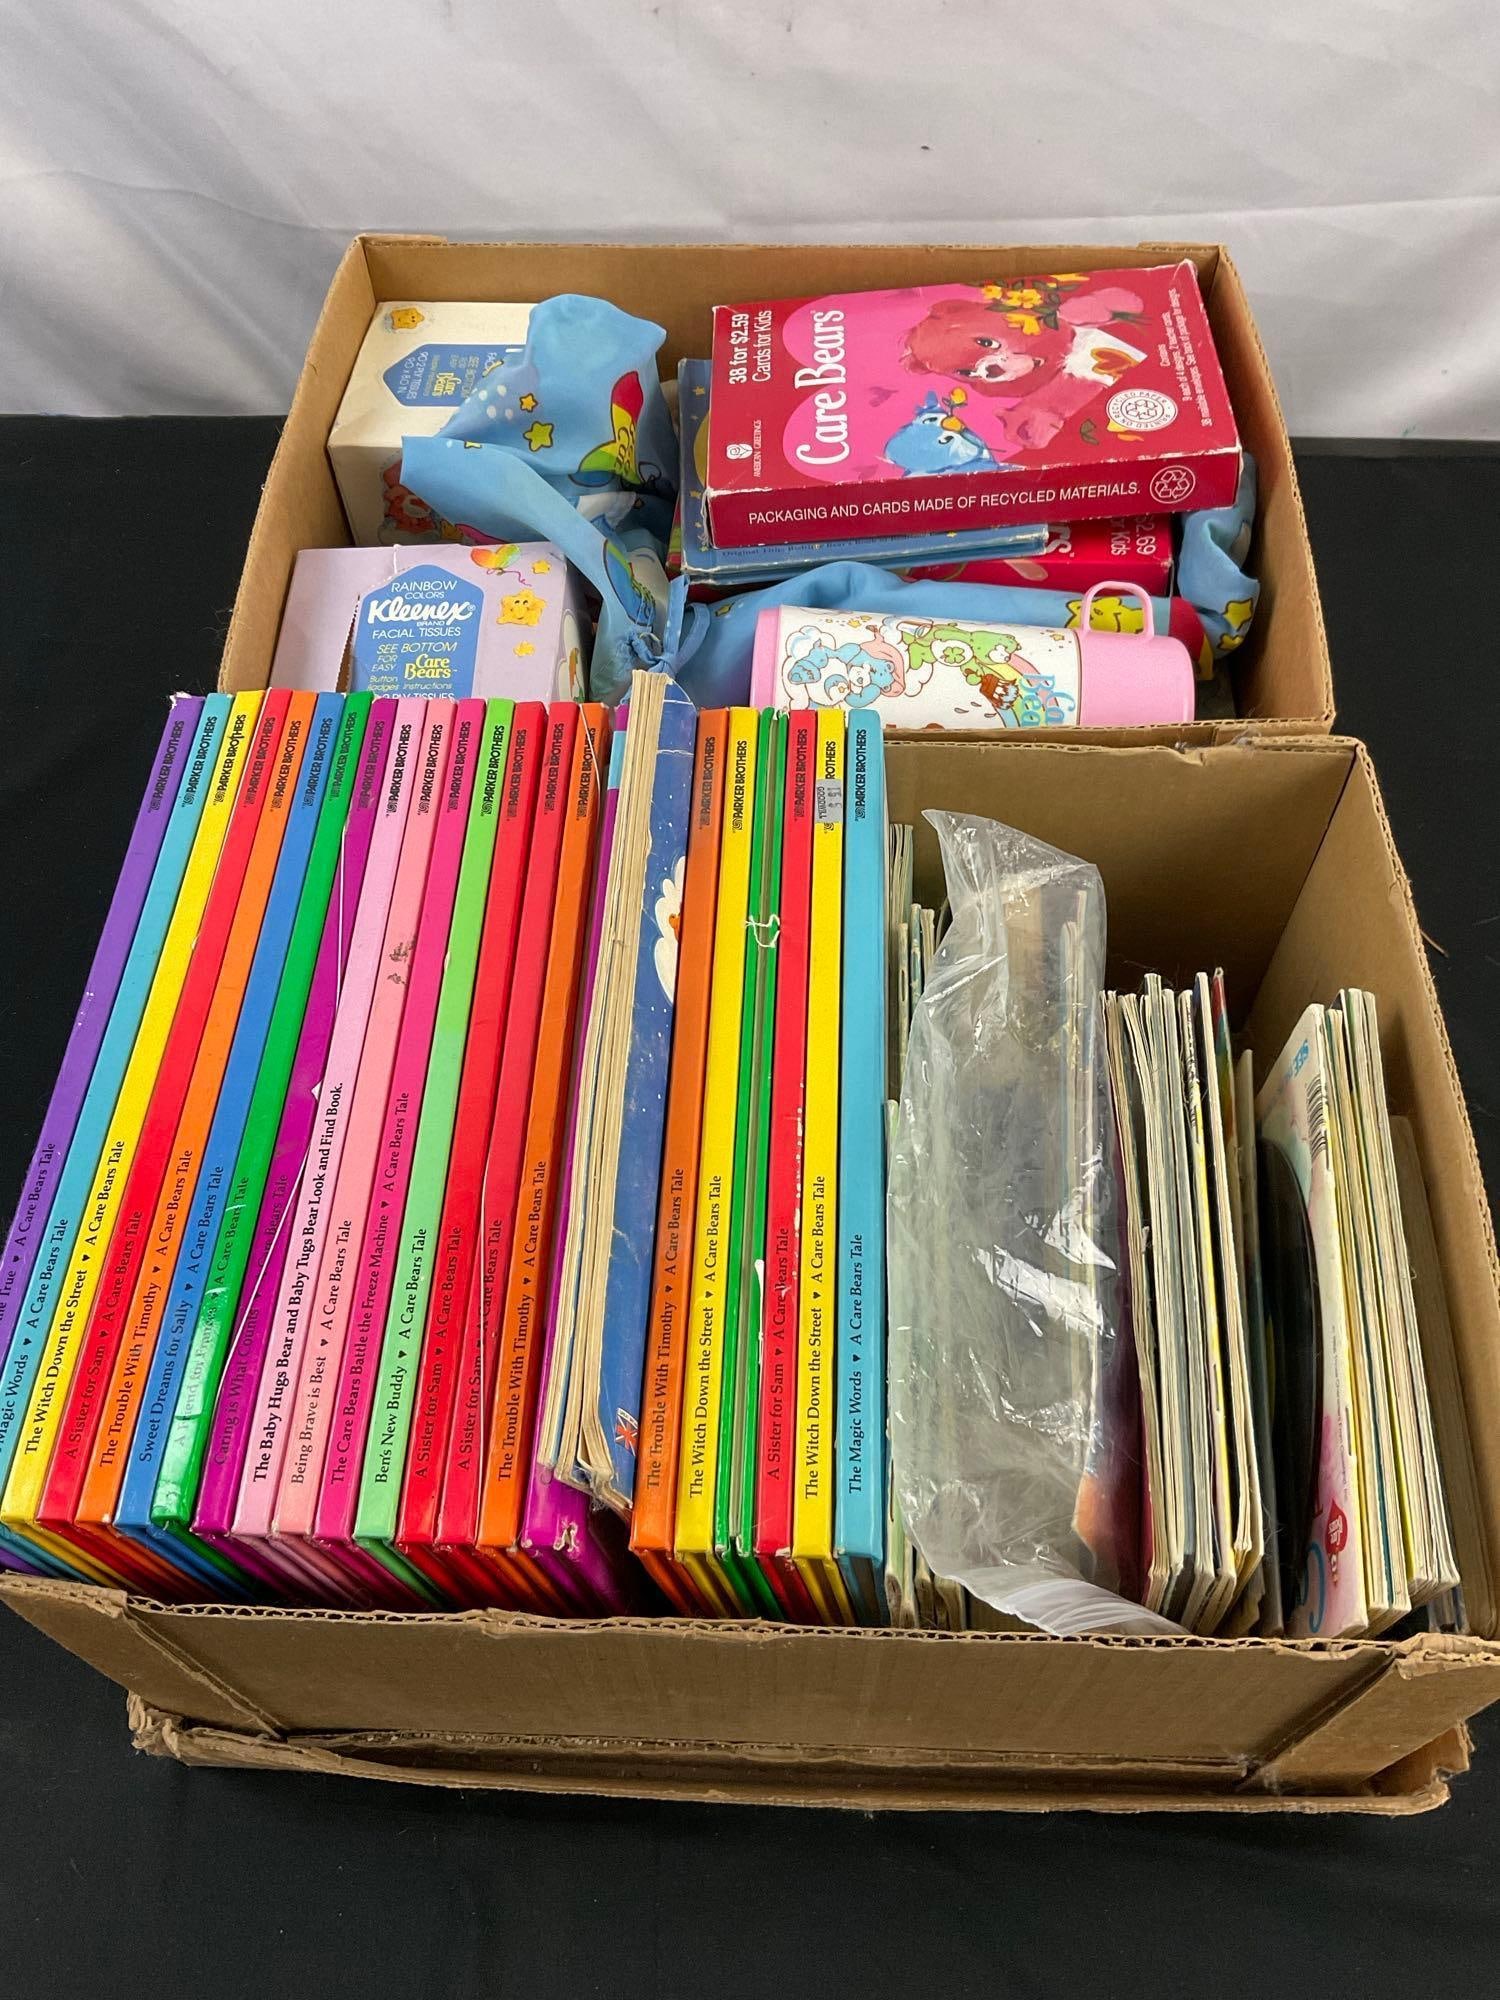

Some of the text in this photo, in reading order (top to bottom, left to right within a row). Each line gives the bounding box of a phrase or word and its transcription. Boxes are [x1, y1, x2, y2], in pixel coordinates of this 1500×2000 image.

[729, 313, 749, 384] 38 for $2.59
[752, 310, 772, 382] Cards for Kids
[794, 310, 850, 465] Care Bears
[749, 482, 1141, 524] PACKAGING AND CARDS MADE OF RECYCLED MATERIALS.
[1111, 531, 1130, 556] Kids
[391, 580, 458, 592] RAINBOW
[405, 591, 445, 600] COLORS
[371, 663, 396, 672] EASY
[372, 627, 461, 639] FACIAL TISSUES
[377, 642, 458, 654] SEE BOTTOM
[378, 655, 398, 663] FOR
[404, 663, 452, 680] Bears
[415, 653, 450, 669] Care
[370, 675, 398, 683] Button
[153, 719, 184, 799] PARKER BROTHERS
[186, 714, 217, 793] PARKER BROTHERS
[217, 712, 247, 791] PARKER BROTHERS
[305, 716, 332, 794] PARKER BROTHERS
[388, 723, 411, 801] PARKER BROTHERS
[483, 724, 504, 802] PARKER BROTHERS
[732, 740, 747, 818] PARKER BROTHERS
[825, 741, 836, 779] ROTHERS
[854, 729, 867, 806] PARKER BROTHERS
[23, 1140, 124, 1455] The Witch Down the Street A Care Bears Tale
[138, 1166, 223, 1462] Sweet Dreams for Sally A Care Bears Tale
[252, 1082, 342, 1482] The Baby Hugs Bear and Baby Tugs Bear Look and Find Book.
[329, 1092, 409, 1485] The Care Bears Battle the Freeze Machine A Care Bears Tale
[290, 1220, 351, 1483] Being Brave is Best A Care Bears Tale
[374, 1228, 426, 1483] Ben's New Buddy A Care Bears Tale
[804, 1175, 825, 1499] The Witch Down the Street A Care Bears Tale
[848, 1234, 864, 1494] The Magic Words A Care Bears Tale
